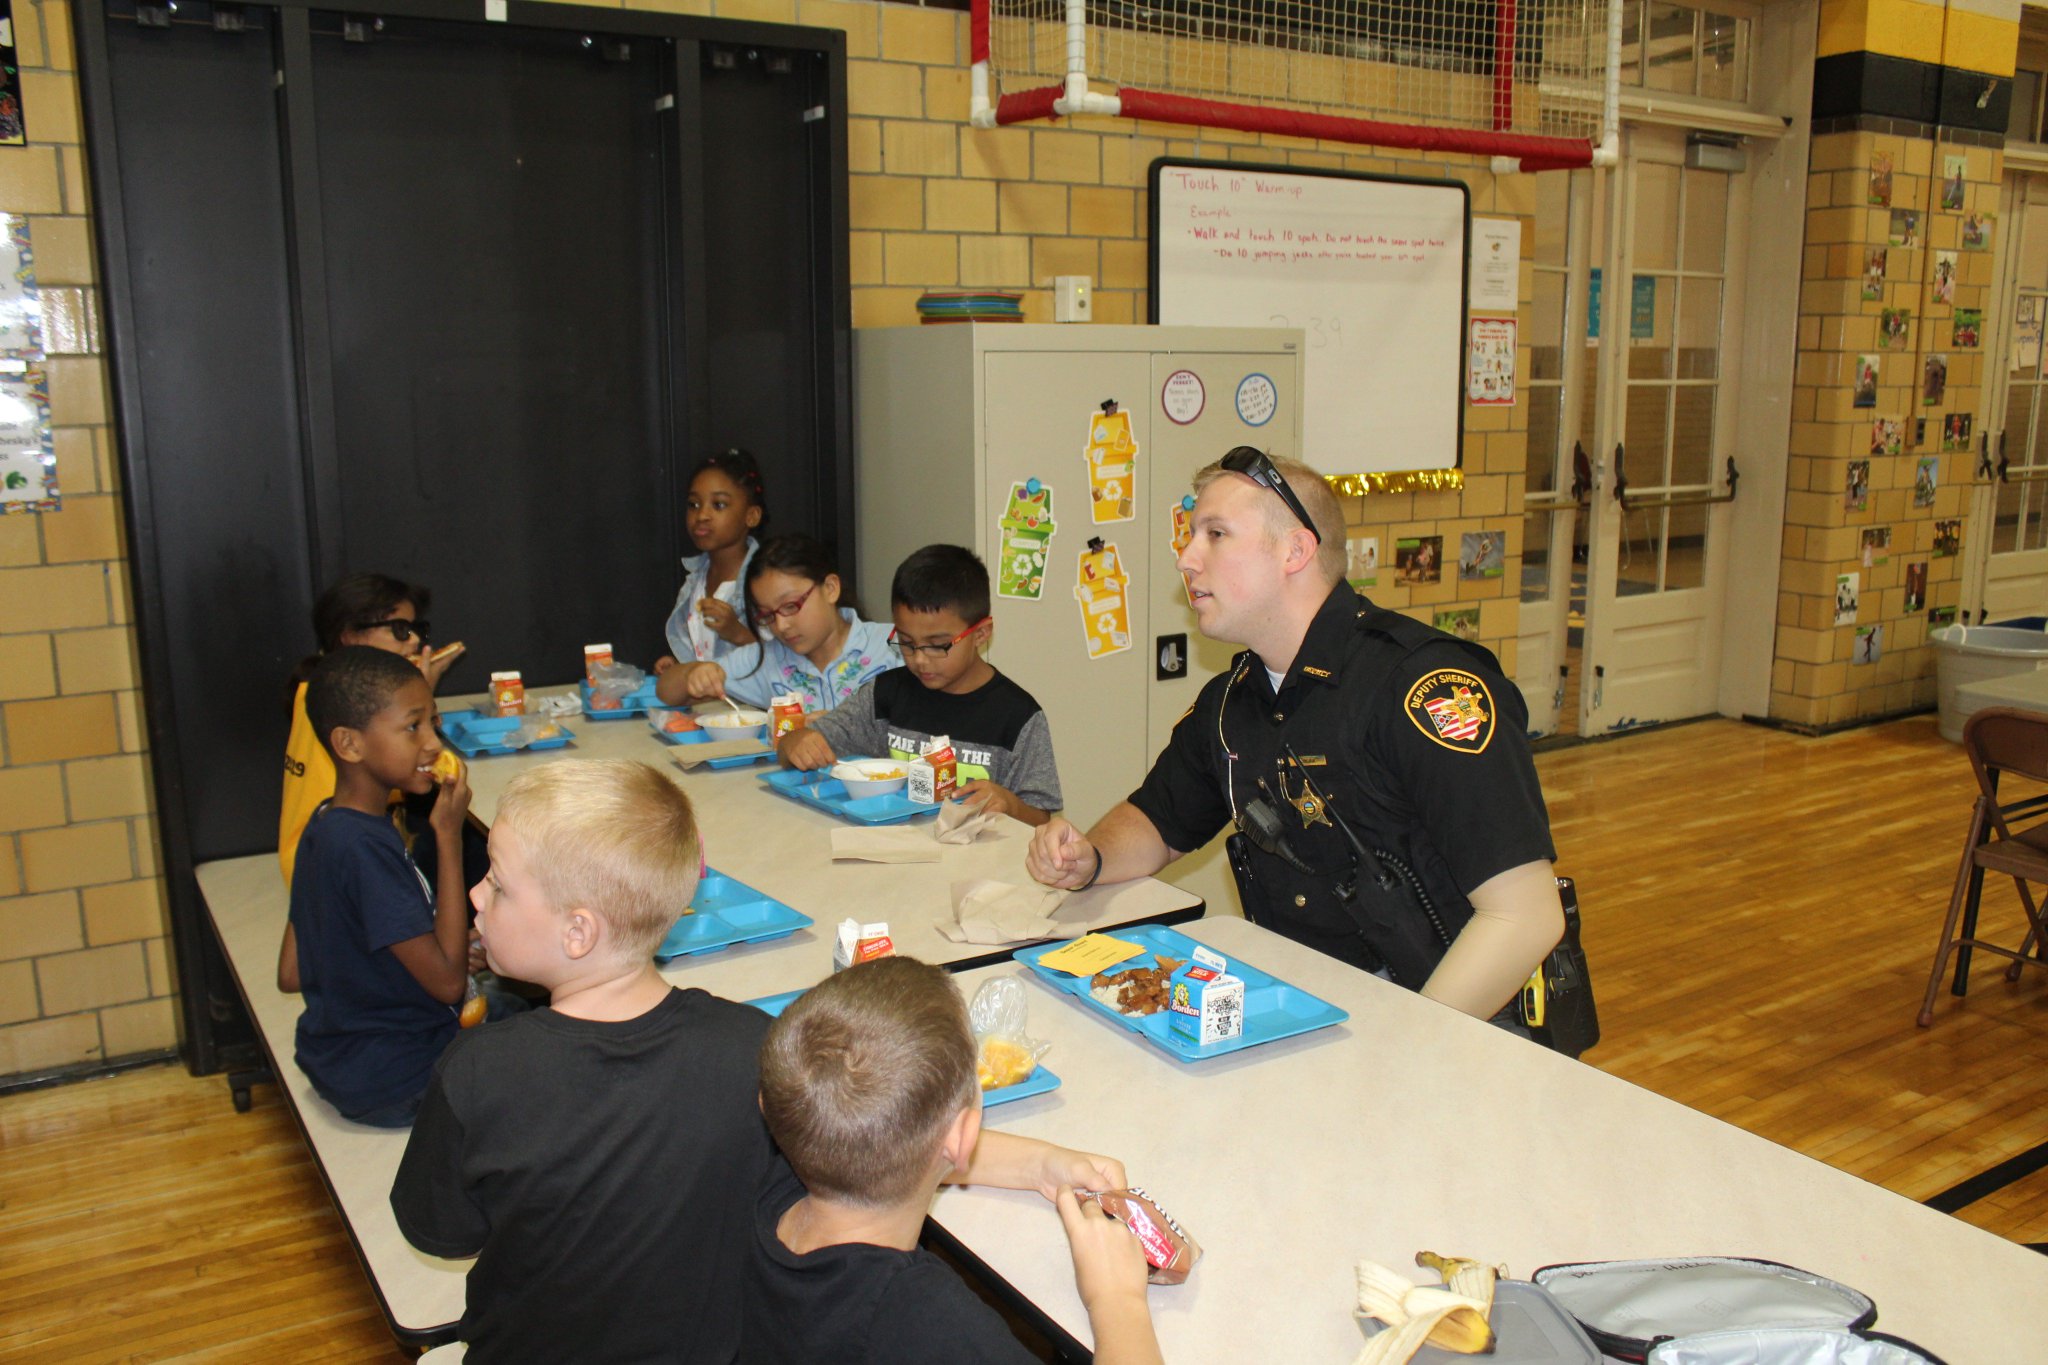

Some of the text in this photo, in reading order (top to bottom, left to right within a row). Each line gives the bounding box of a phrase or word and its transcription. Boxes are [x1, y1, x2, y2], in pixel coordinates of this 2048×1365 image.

[1223, 228, 1240, 240] and
[1249, 228, 1275, 241] touch
[1283, 230, 1293, 241] 10
[1237, 247, 1248, 258] 10
[1410, 673, 1479, 709] DEPUTY SHERIFF
[961, 748, 992, 767] THE
[1171, 998, 1201, 1018] Borden
